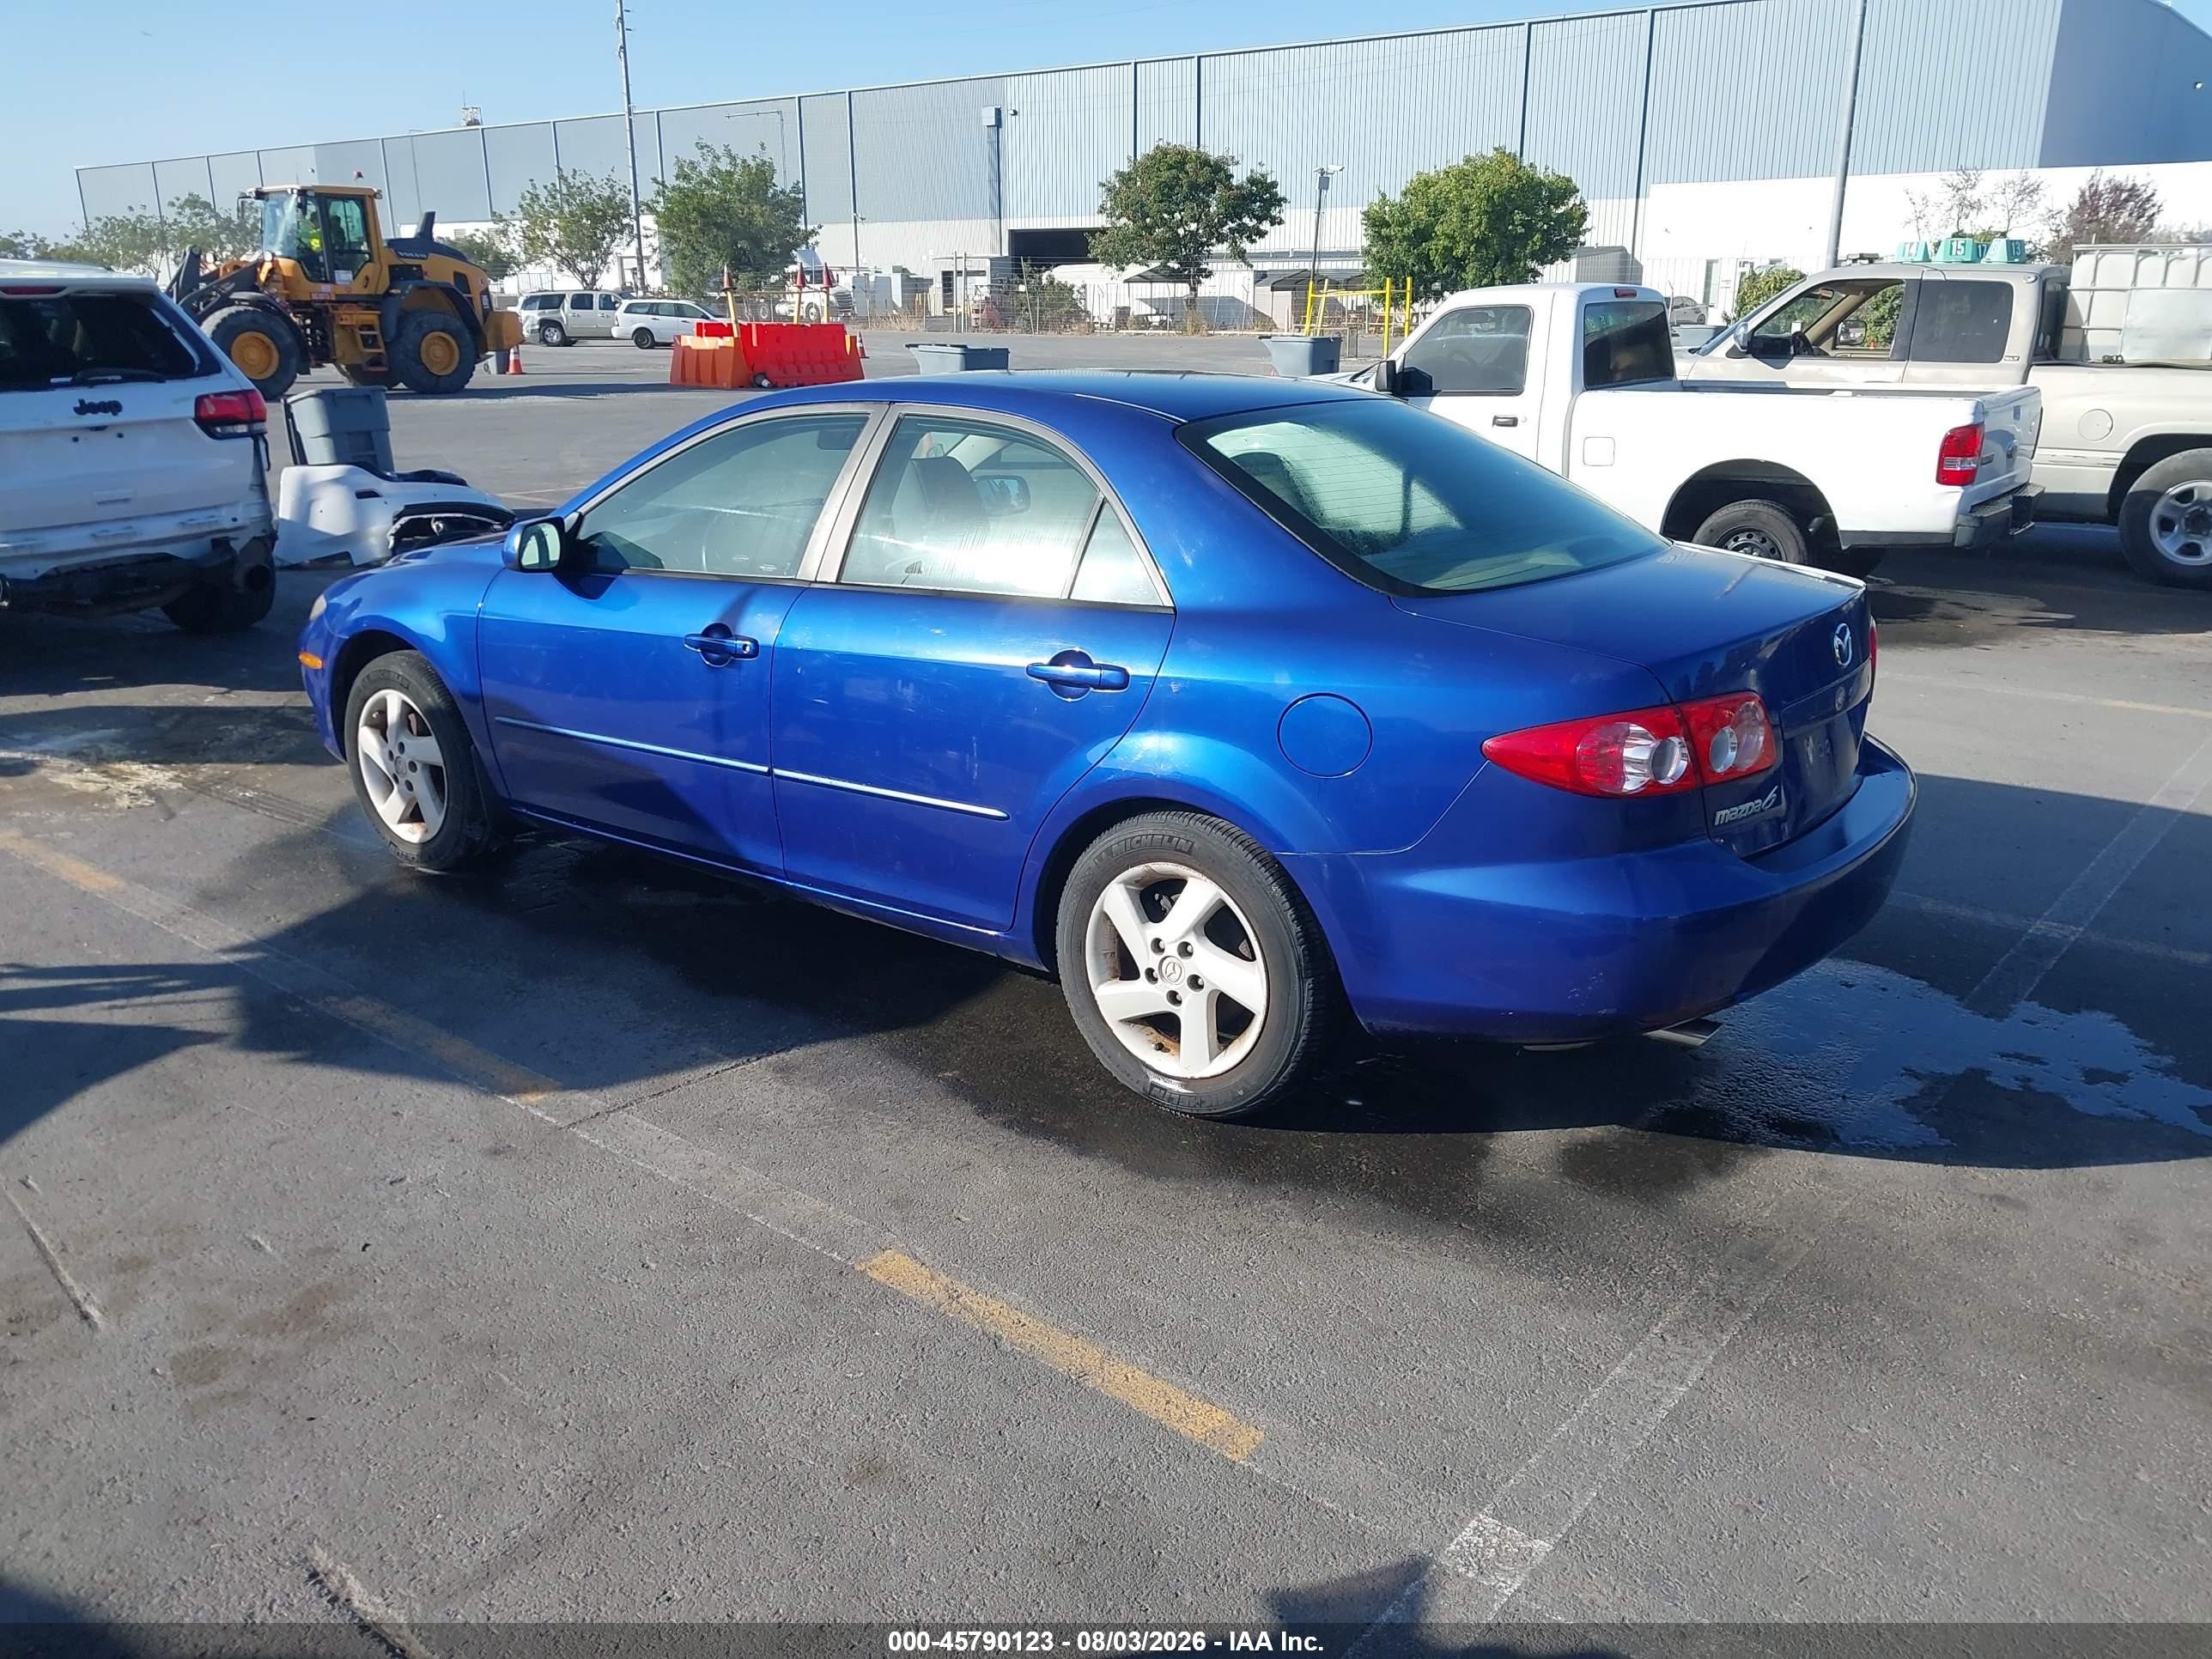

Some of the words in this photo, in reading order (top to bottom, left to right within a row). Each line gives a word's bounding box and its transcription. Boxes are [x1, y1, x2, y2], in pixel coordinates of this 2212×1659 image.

[1950, 240, 1966, 256] 15
[2011, 241, 2021, 256] 13
[73, 398, 123, 416] Jeep
[1111, 834, 1194, 857] MICHELIN
